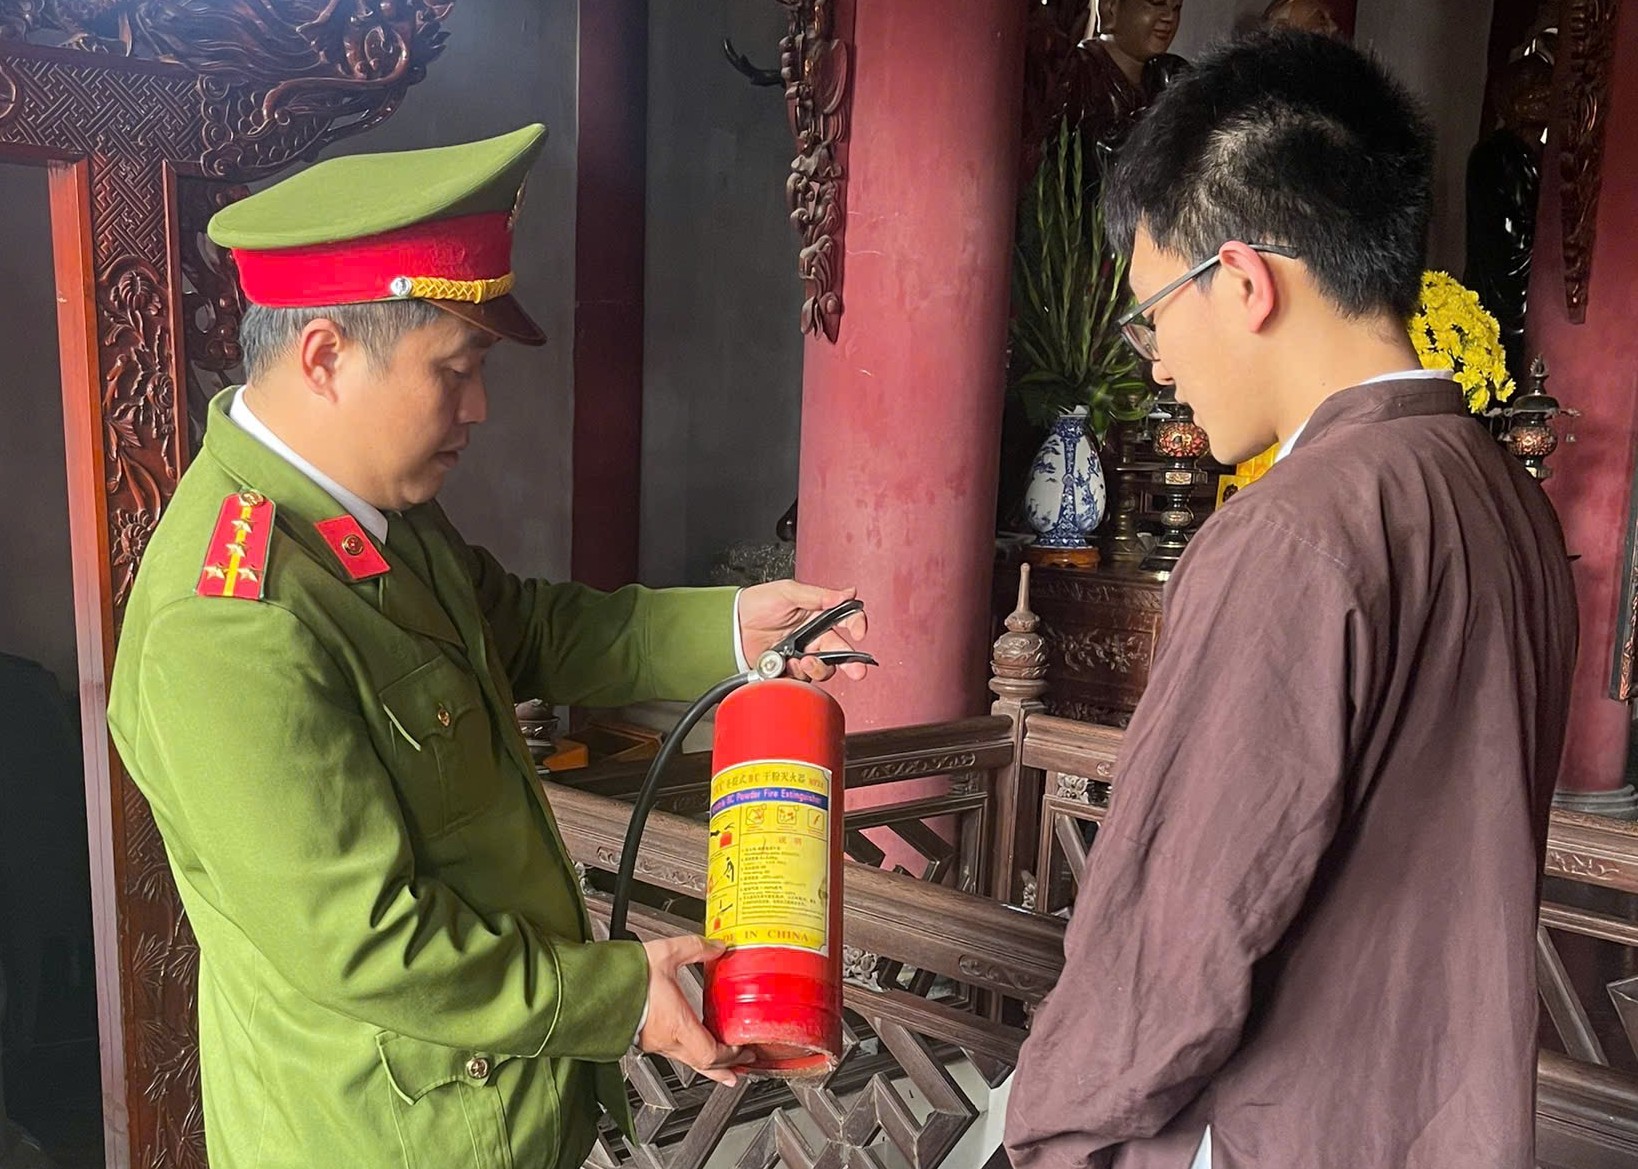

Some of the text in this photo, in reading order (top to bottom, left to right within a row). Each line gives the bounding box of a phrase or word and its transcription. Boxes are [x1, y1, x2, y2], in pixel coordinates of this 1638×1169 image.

[736, 790, 761, 801] Powder
[764, 788, 779, 798] Fire
[745, 930, 758, 939] IN
[767, 930, 809, 942] CHINA
